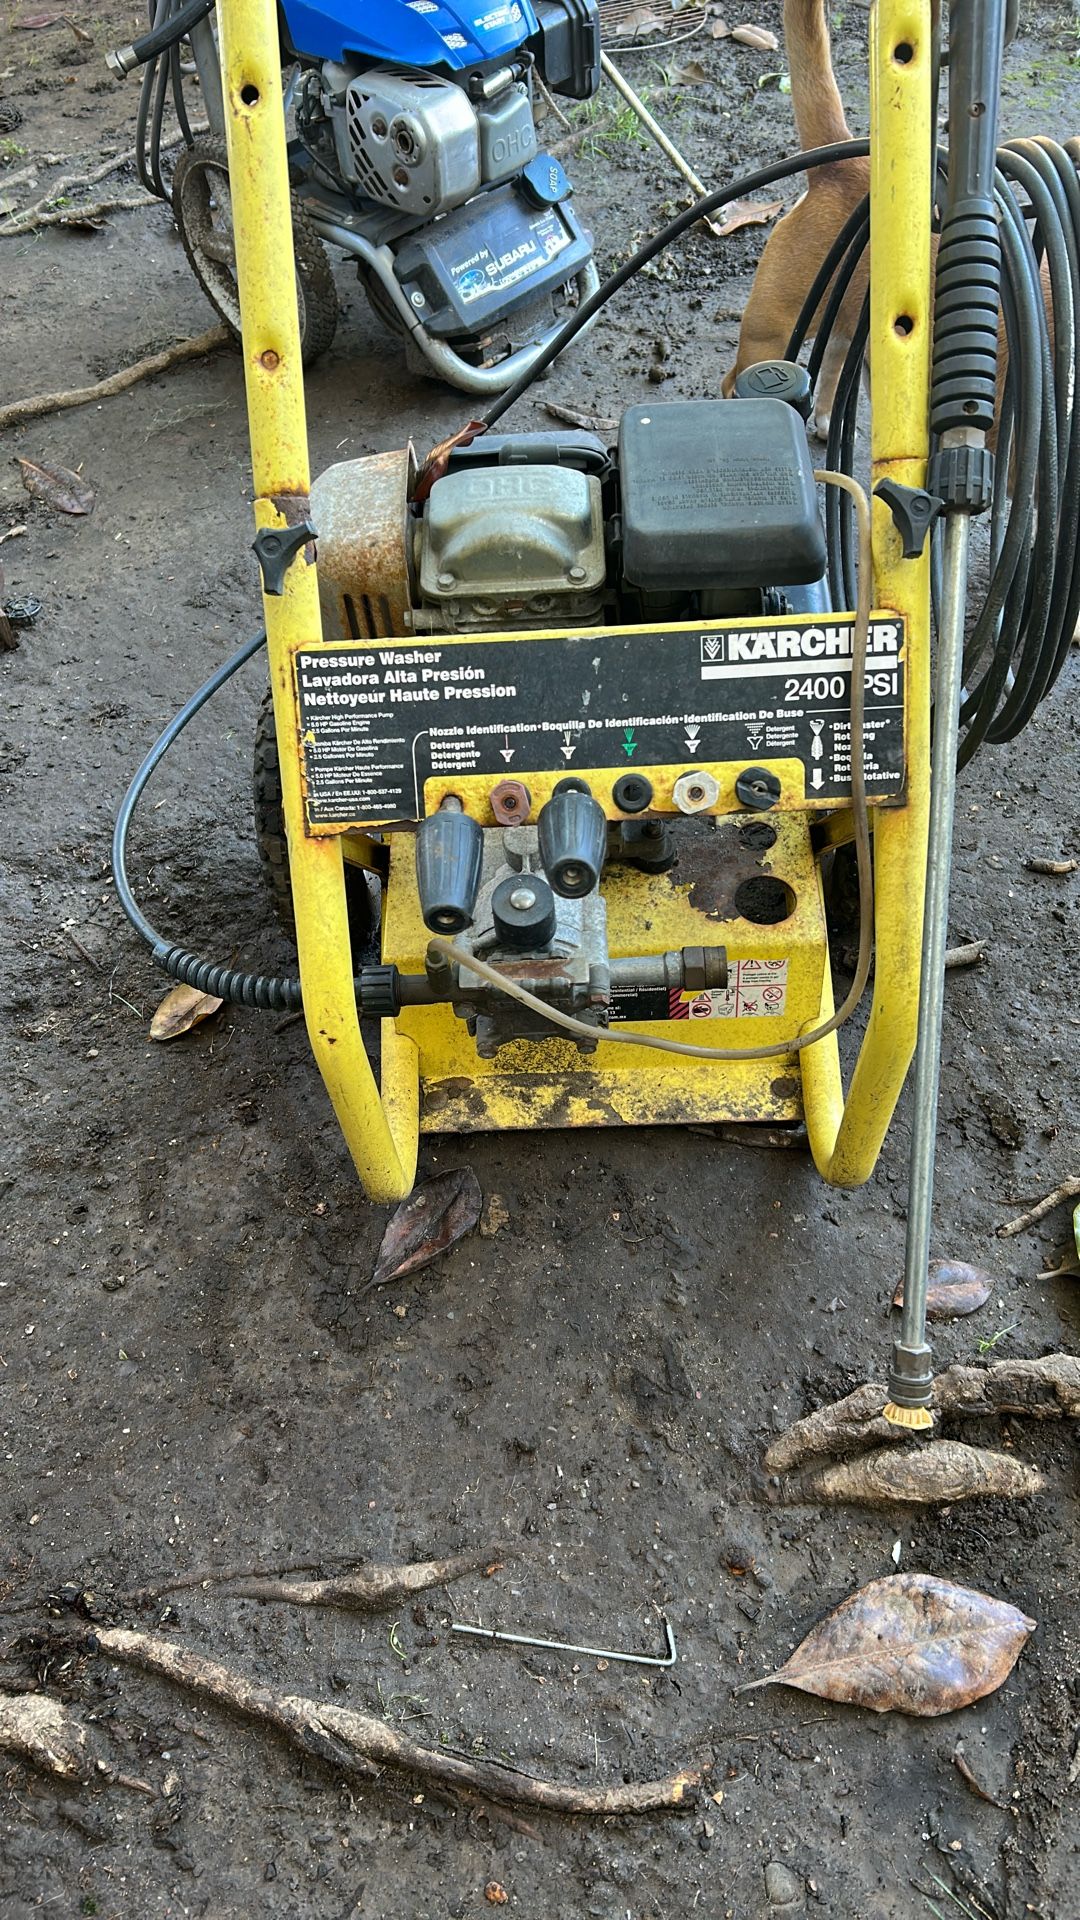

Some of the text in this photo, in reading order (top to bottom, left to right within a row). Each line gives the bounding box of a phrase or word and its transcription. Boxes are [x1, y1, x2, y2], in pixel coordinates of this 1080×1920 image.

[492, 124, 533, 163] OHC
[550, 166, 558, 193] SOAP
[451, 249, 489, 276] Powered by
[485, 240, 537, 276] SUBARU
[301, 651, 441, 669] Pressure Washer
[302, 666, 485, 687] Lavadora Alta Presión
[304, 685, 516, 706] Nettoyeur Haute Pression
[784, 676, 845, 701] 2400
[429, 709, 804, 736] Nozzle Identification Boquilla De Identificación Identification De Buse
[766, 725, 795, 733] Detergent
[833, 721, 885, 730] Dirtster
[834, 732, 875, 741] Rotng
[430, 741, 475, 750] Detergent
[431, 750, 481, 759] Detergente
[833, 753, 873, 762] Boqla
[432, 760, 476, 770] Détergent
[834, 762, 879, 772] Rotria
[864, 771, 900, 780] otative
